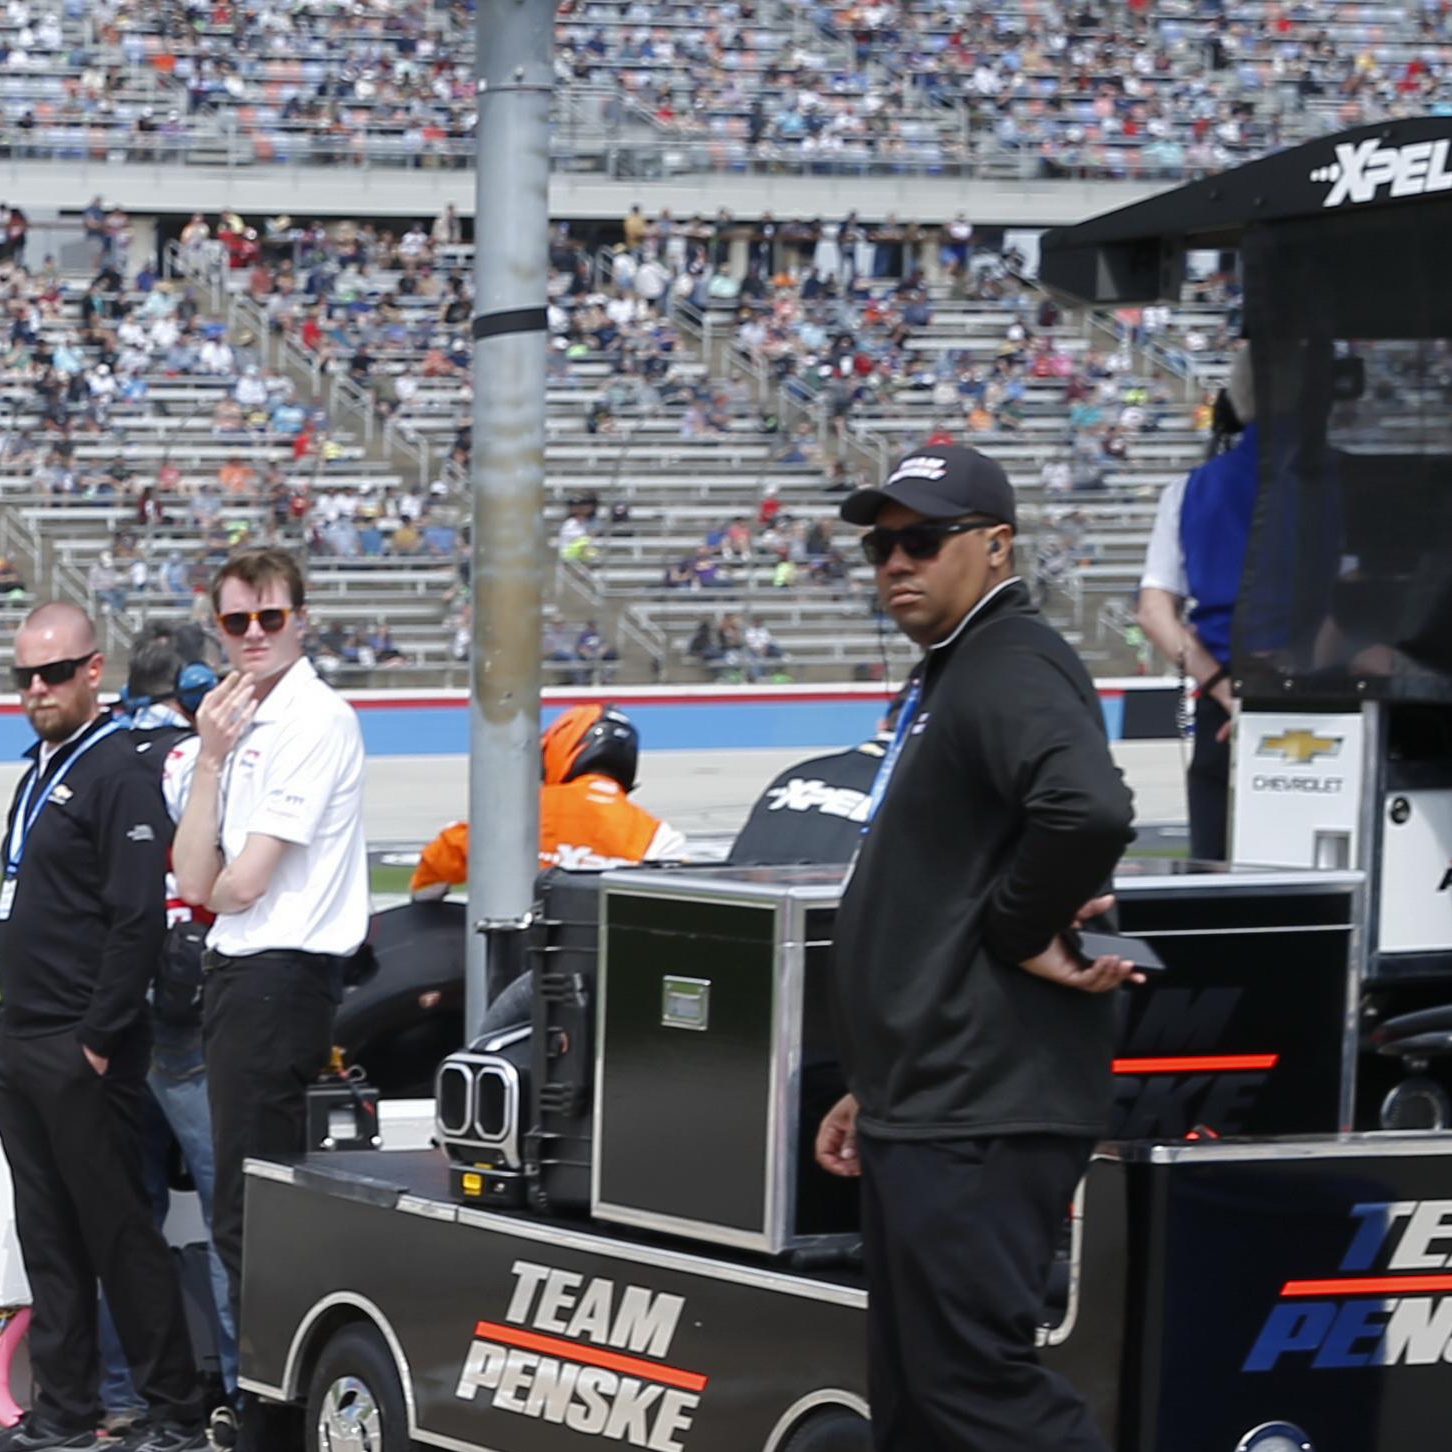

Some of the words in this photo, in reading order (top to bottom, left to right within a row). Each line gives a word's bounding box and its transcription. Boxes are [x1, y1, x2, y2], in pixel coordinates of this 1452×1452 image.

[1323, 138, 1452, 207] XPEL
[1253, 776, 1344, 793] CHEVROLET
[505, 1260, 685, 1358] TEAM
[1241, 1297, 1452, 1373] PEN
